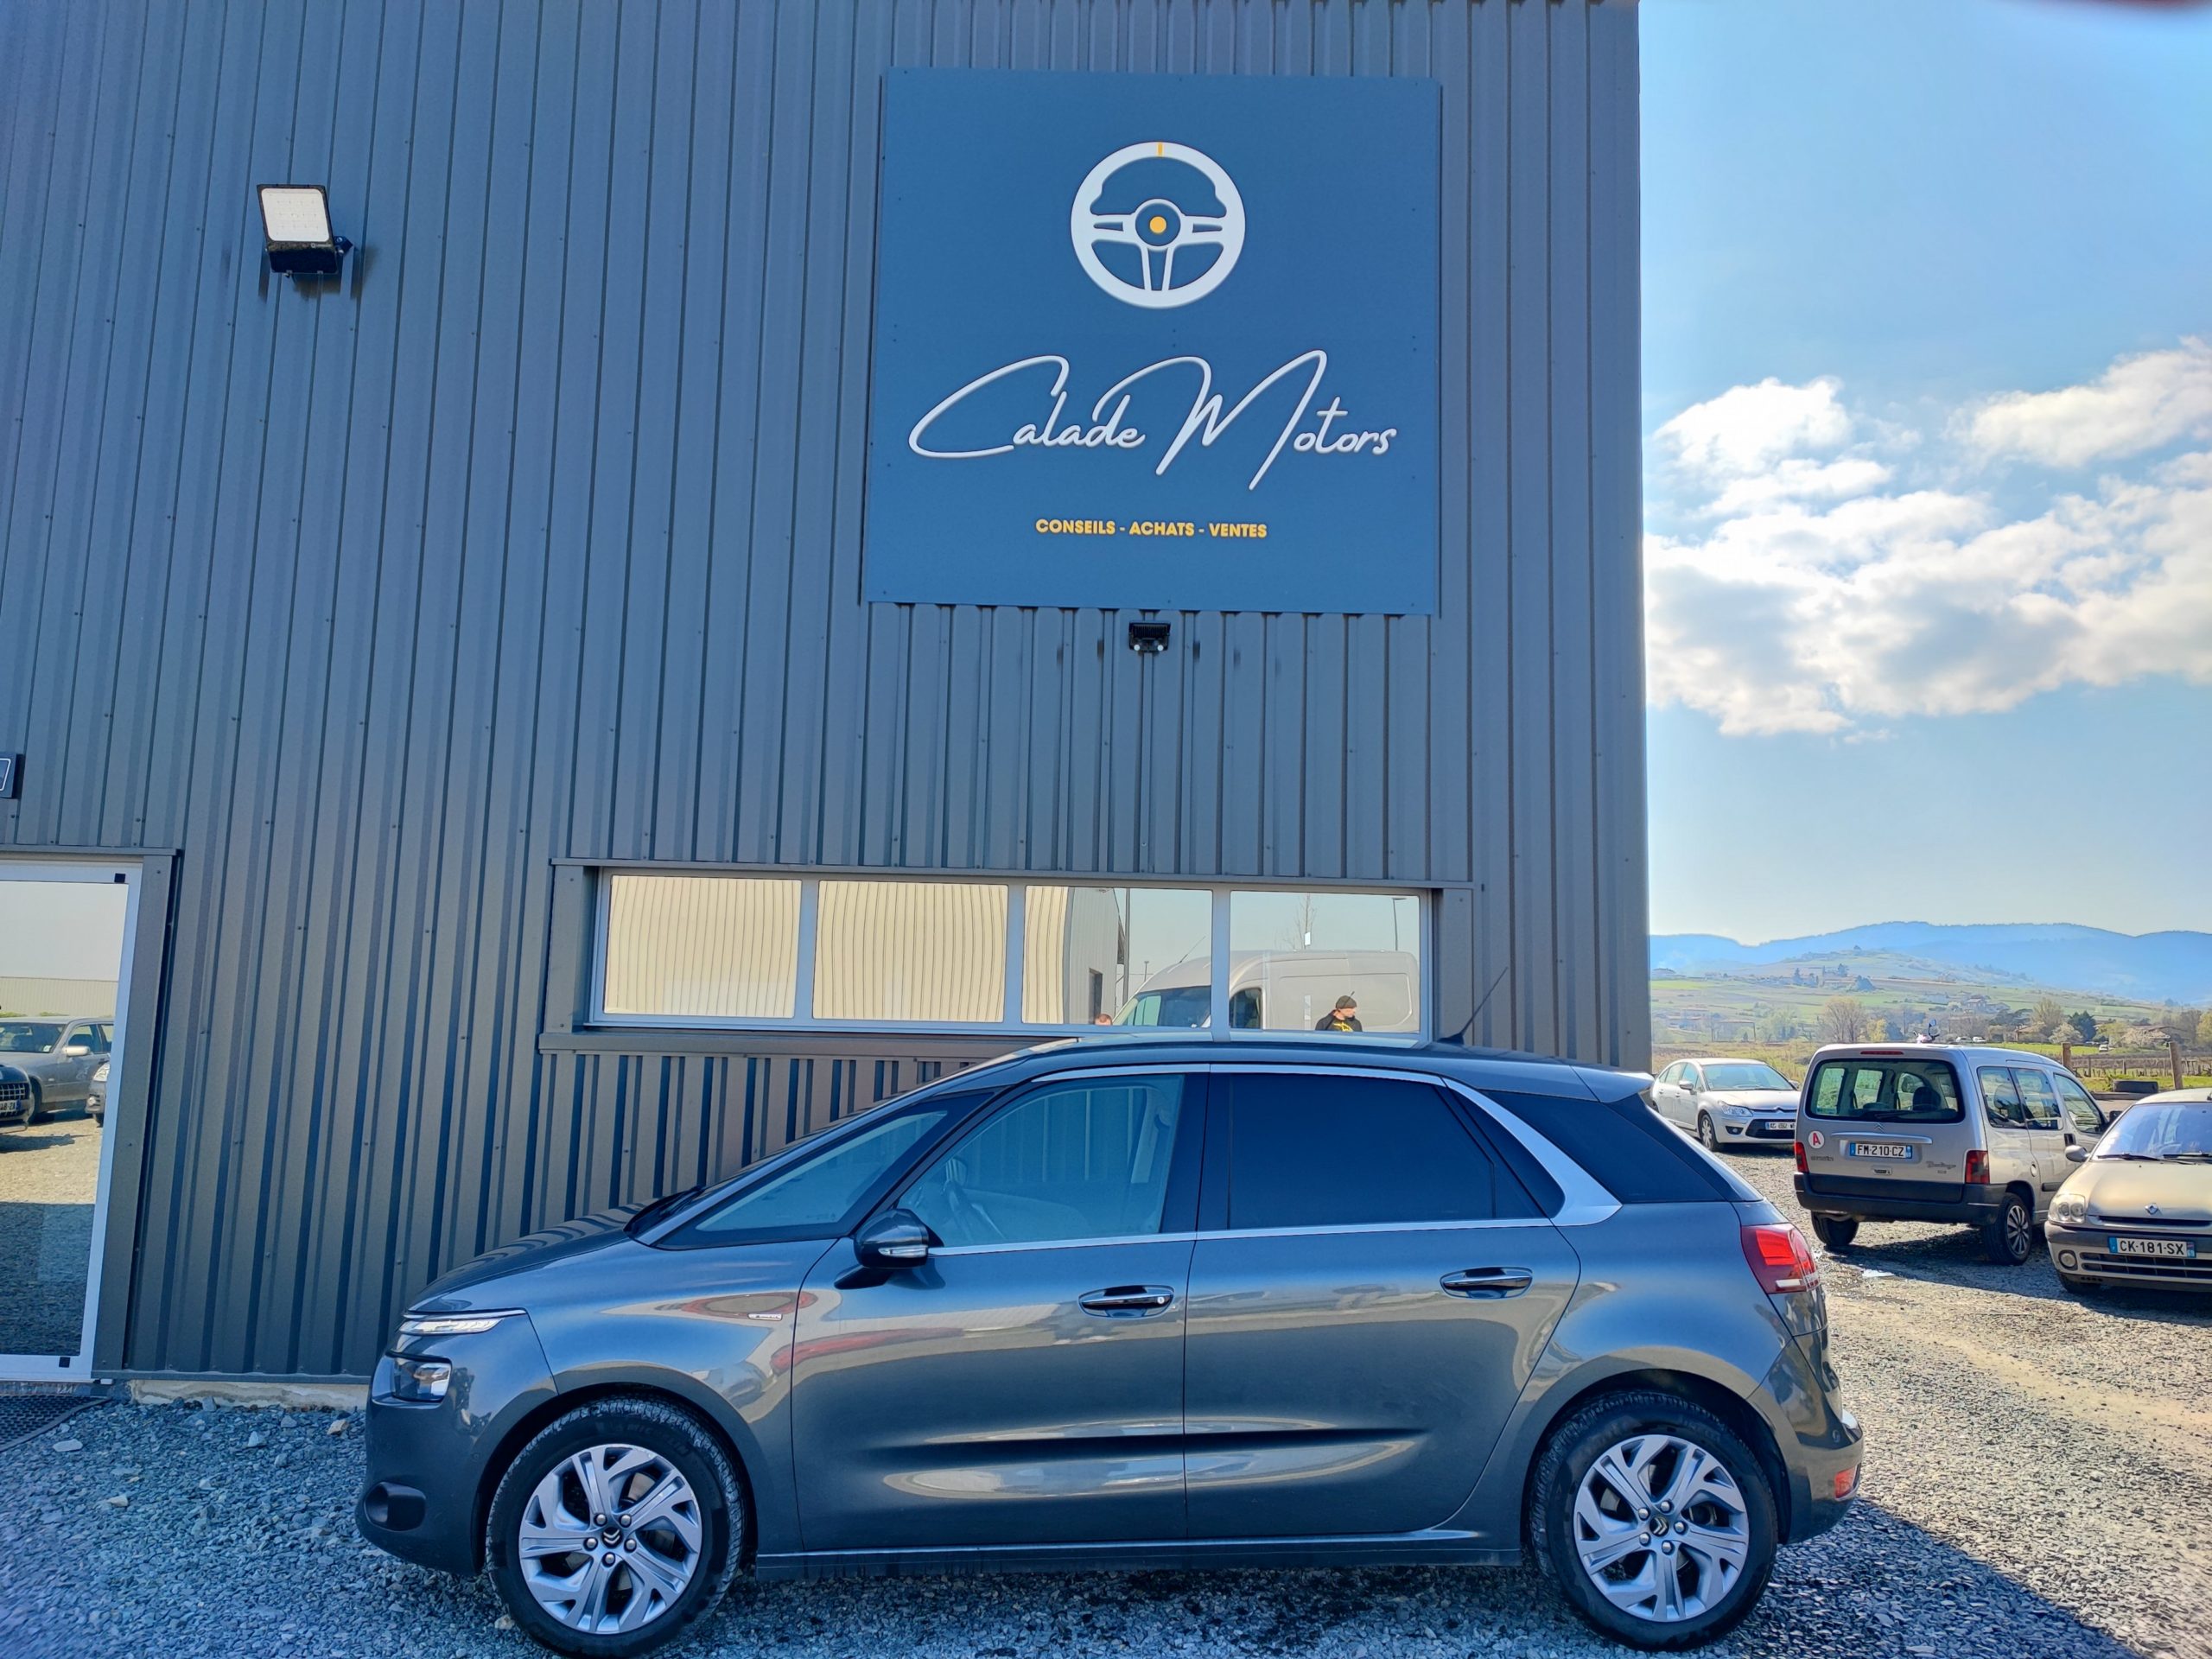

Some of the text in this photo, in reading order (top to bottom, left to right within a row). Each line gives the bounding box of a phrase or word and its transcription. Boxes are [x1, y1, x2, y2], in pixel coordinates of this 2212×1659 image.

[908, 349, 1397, 491] Calade Motors
[1035, 518, 1116, 535] CONSEILS
[1128, 520, 1194, 537] ACHATS
[1209, 522, 1268, 538] VENTES
[1813, 1133, 1821, 1146] A
[1857, 1145, 1904, 1157] FM-210-CZ
[2120, 1240, 2184, 1255] CK-181-SX
